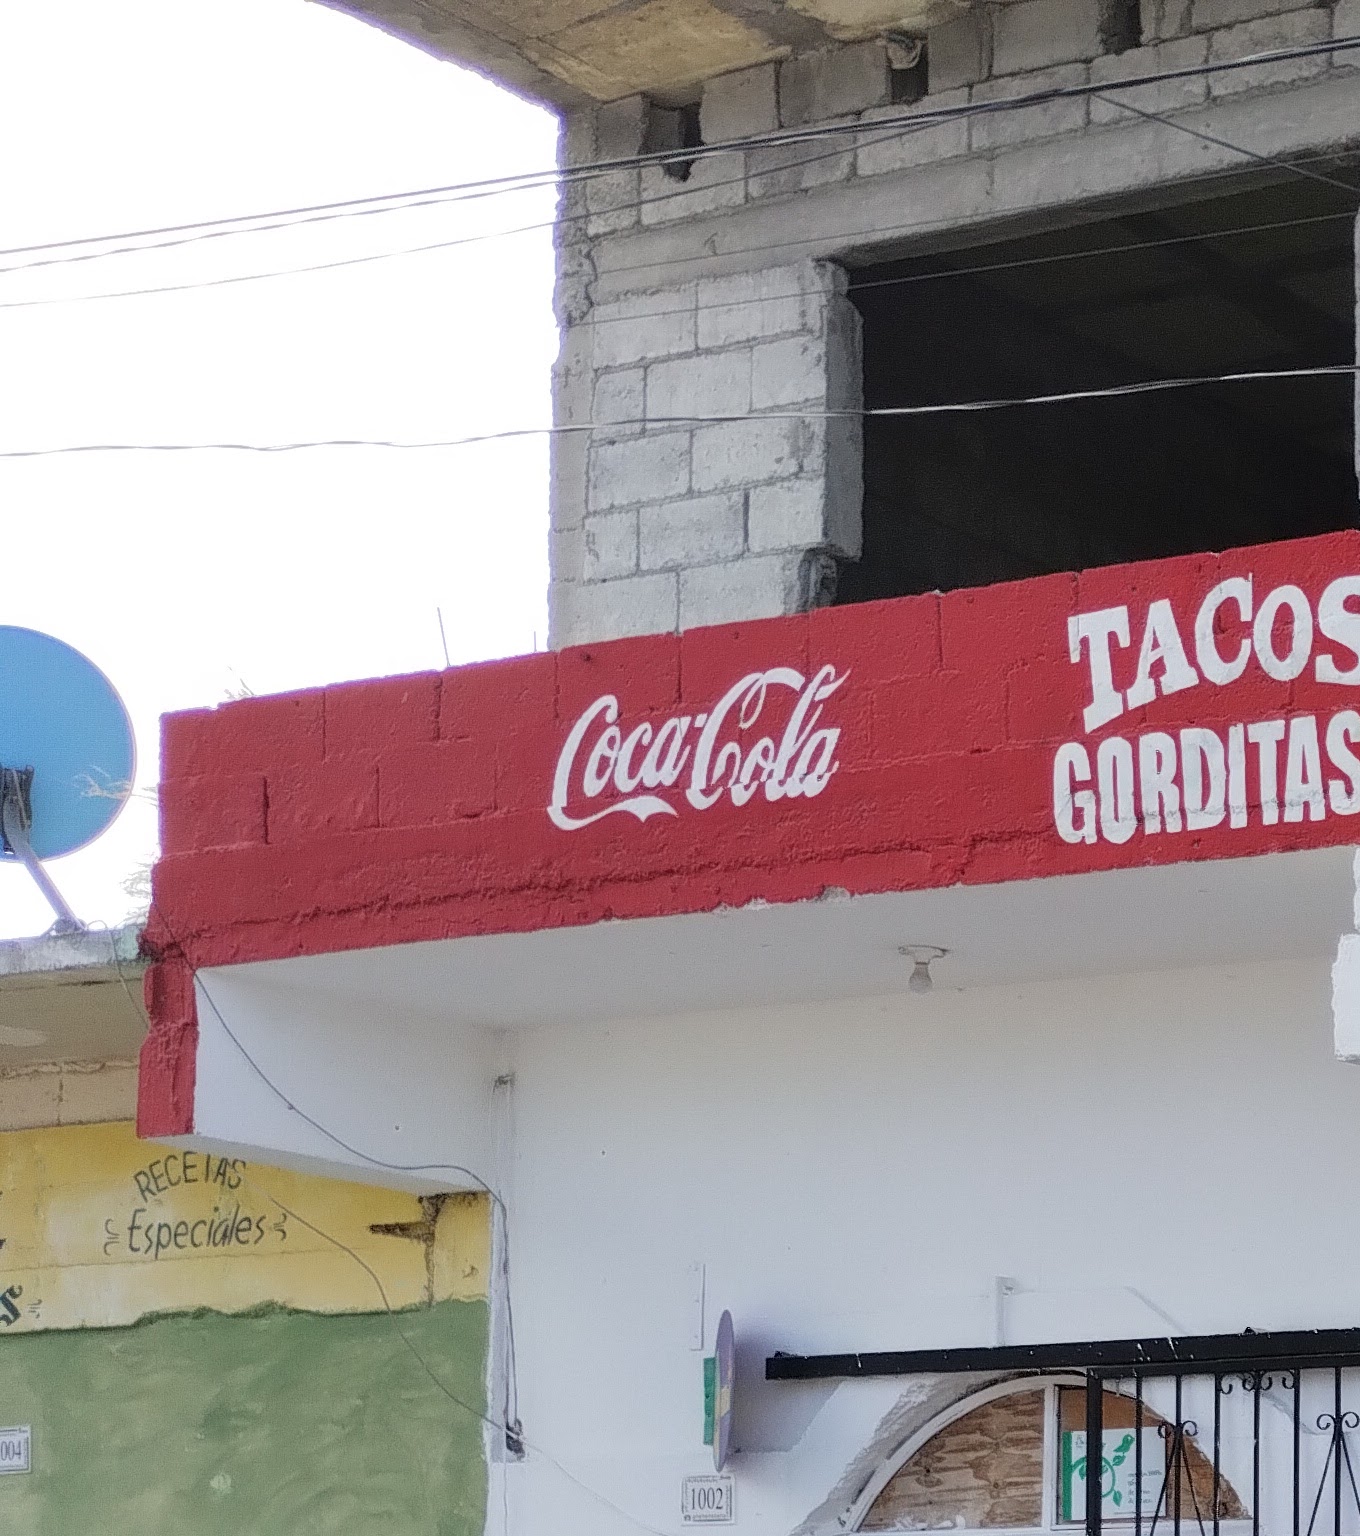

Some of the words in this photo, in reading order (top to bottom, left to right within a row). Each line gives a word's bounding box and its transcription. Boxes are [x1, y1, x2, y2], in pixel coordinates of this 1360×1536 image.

[547, 664, 851, 831] Coca-Cola
[127, 1203, 265, 1260] Especiales
[691, 1487, 723, 1510] 1002
